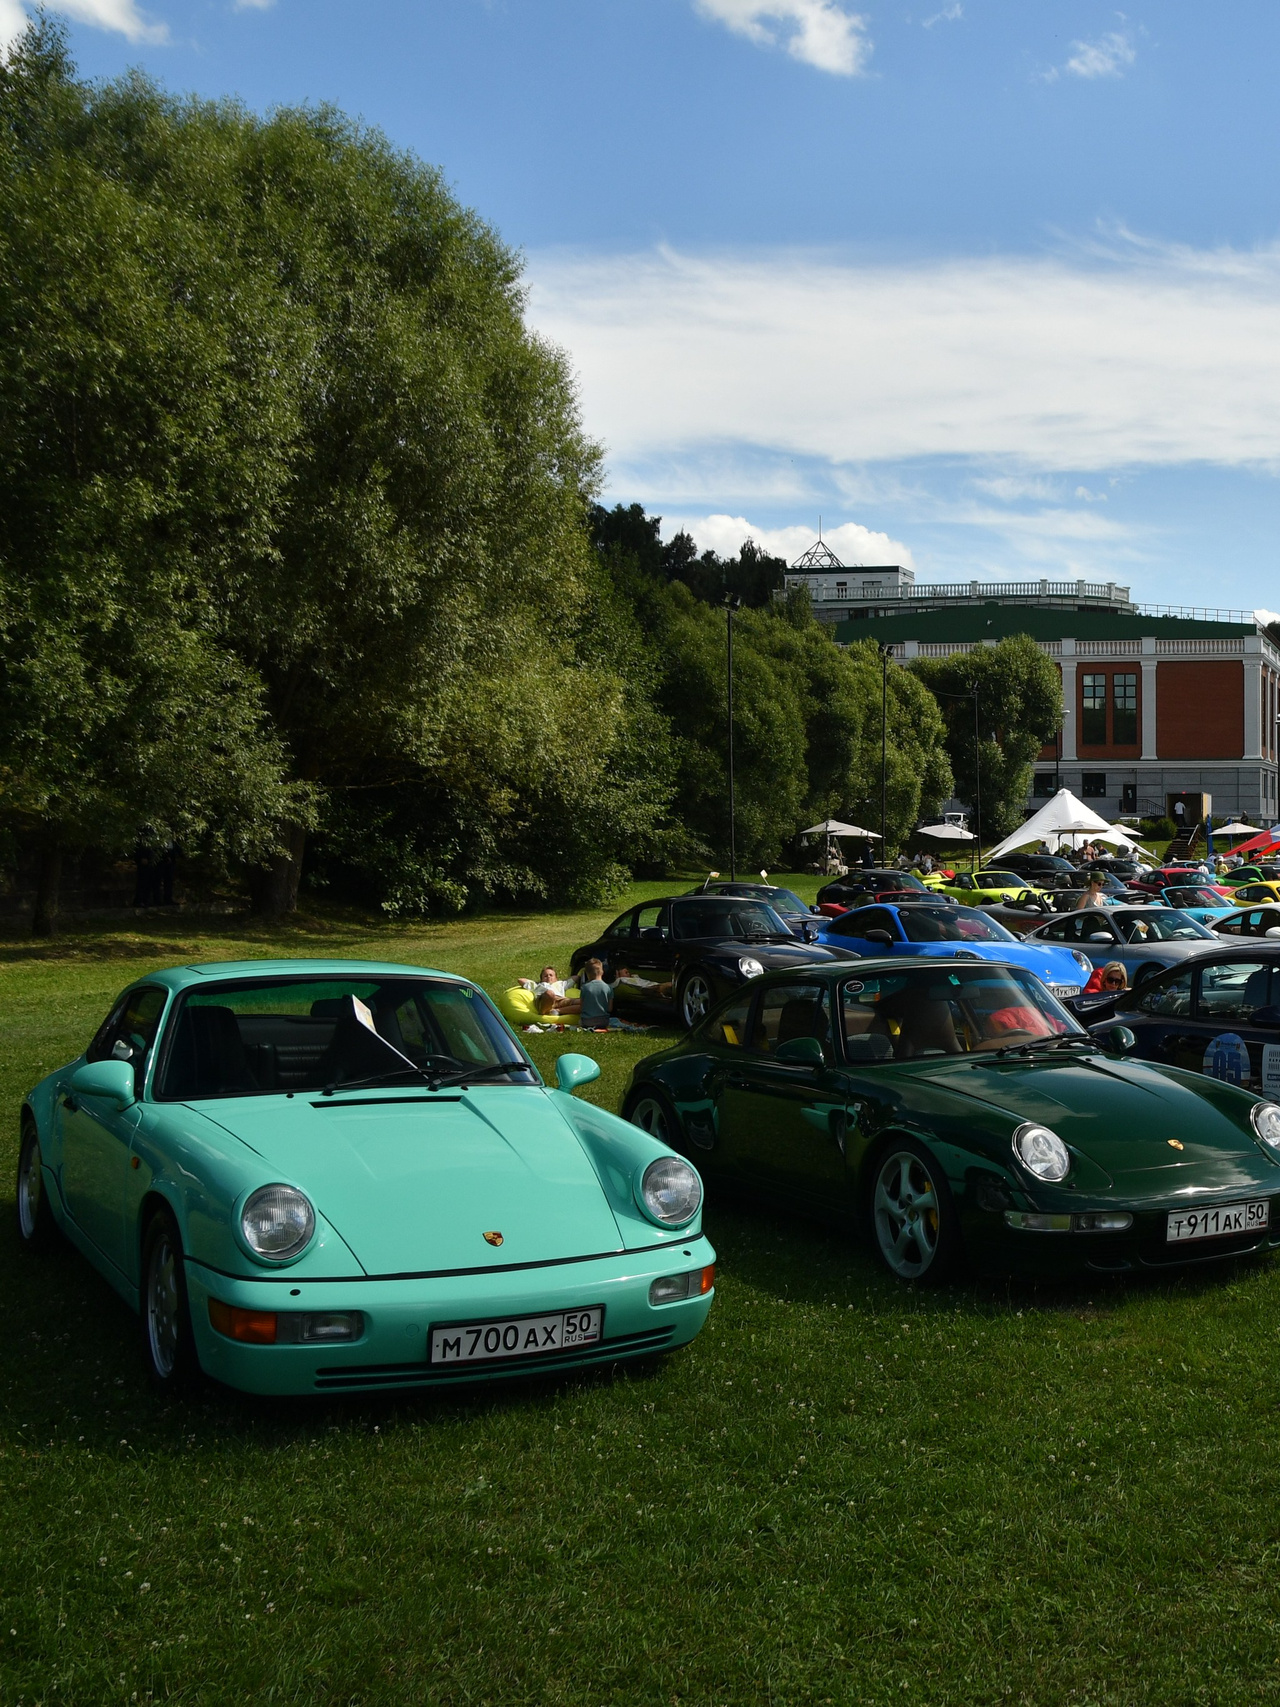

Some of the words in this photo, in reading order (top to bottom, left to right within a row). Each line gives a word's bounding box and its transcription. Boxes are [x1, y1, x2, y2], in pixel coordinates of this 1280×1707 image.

[1174, 1211, 1243, 1237] Т911АК
[1248, 1204, 1264, 1221] 50
[442, 1324, 557, 1359] М700АХ
[565, 1313, 592, 1335] 50
[564, 1333, 583, 1344] RUS
